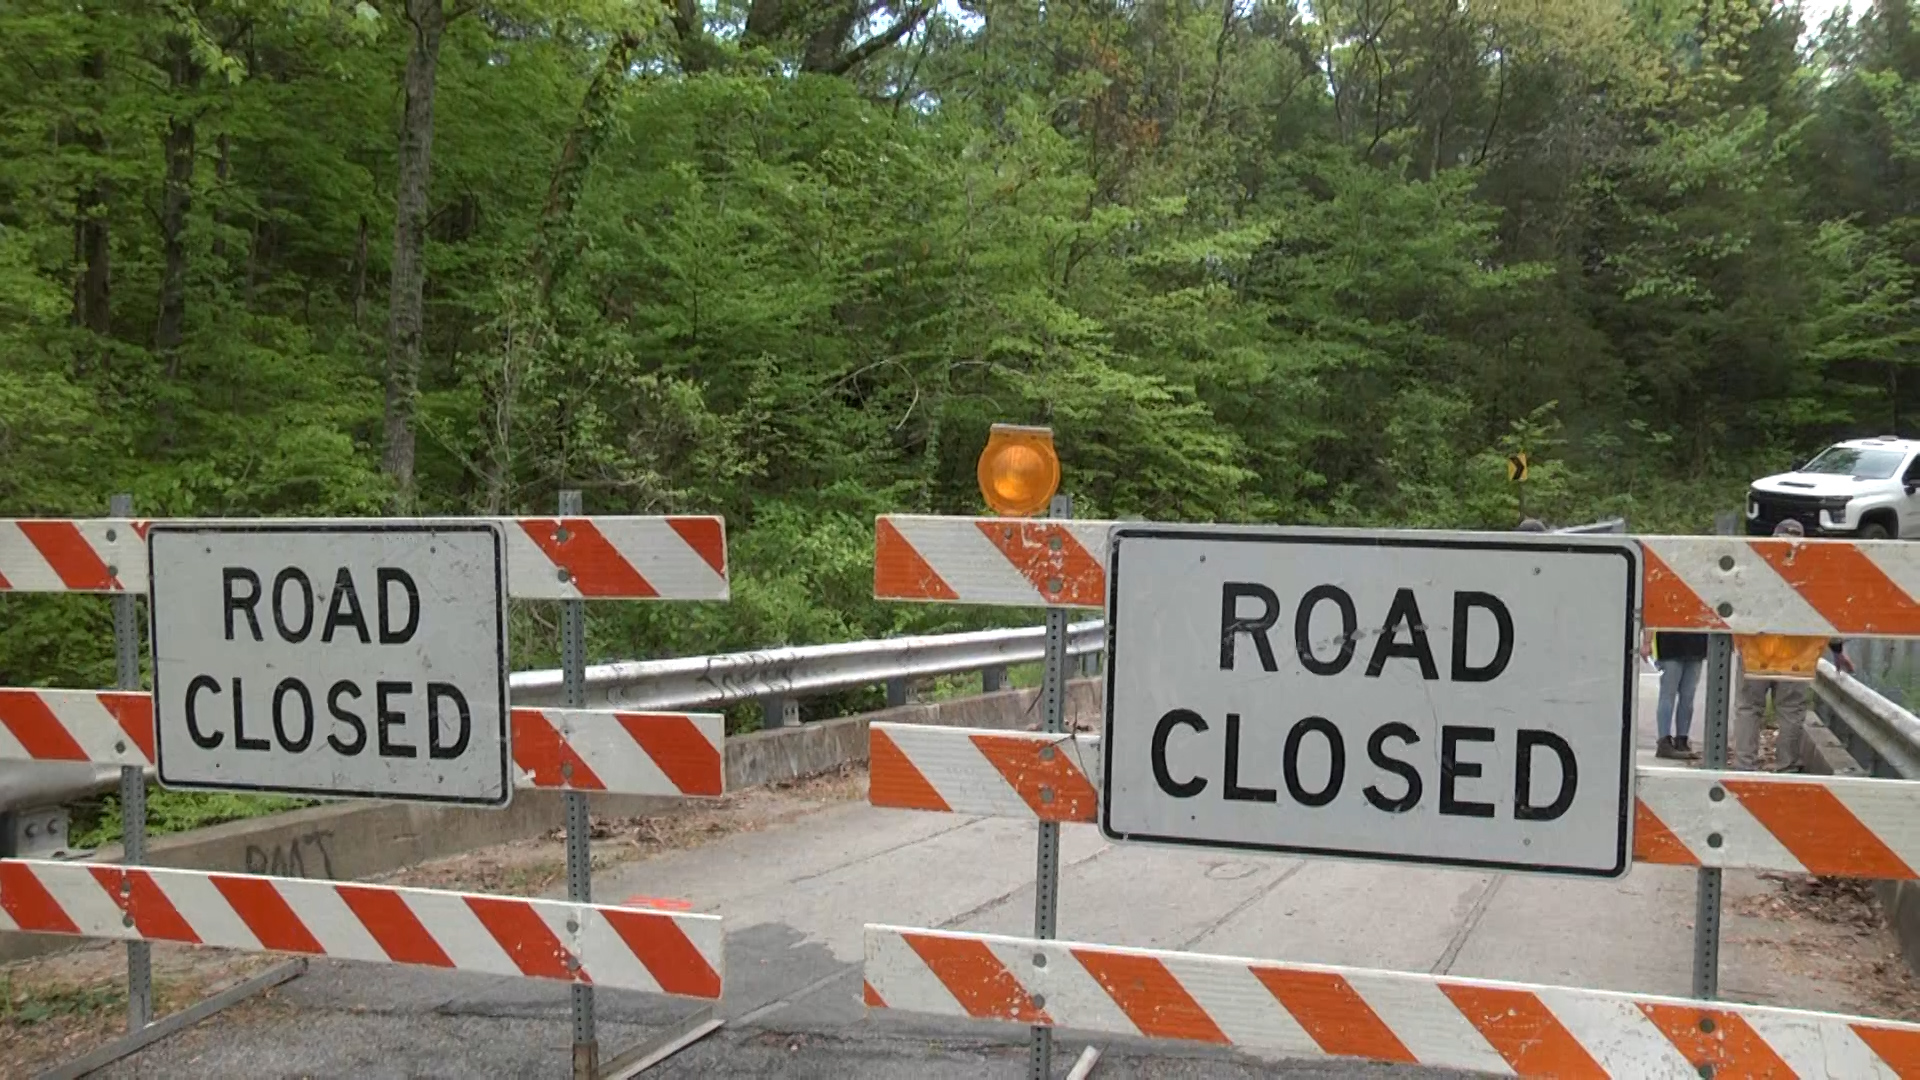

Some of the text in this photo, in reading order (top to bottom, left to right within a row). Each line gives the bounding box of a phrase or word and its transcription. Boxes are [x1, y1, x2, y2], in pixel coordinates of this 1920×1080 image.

[222, 566, 420, 645] ROAD
[1219, 581, 1515, 682] ROAD
[184, 674, 472, 760] CLOSED
[1150, 708, 1579, 822] CLOSED
